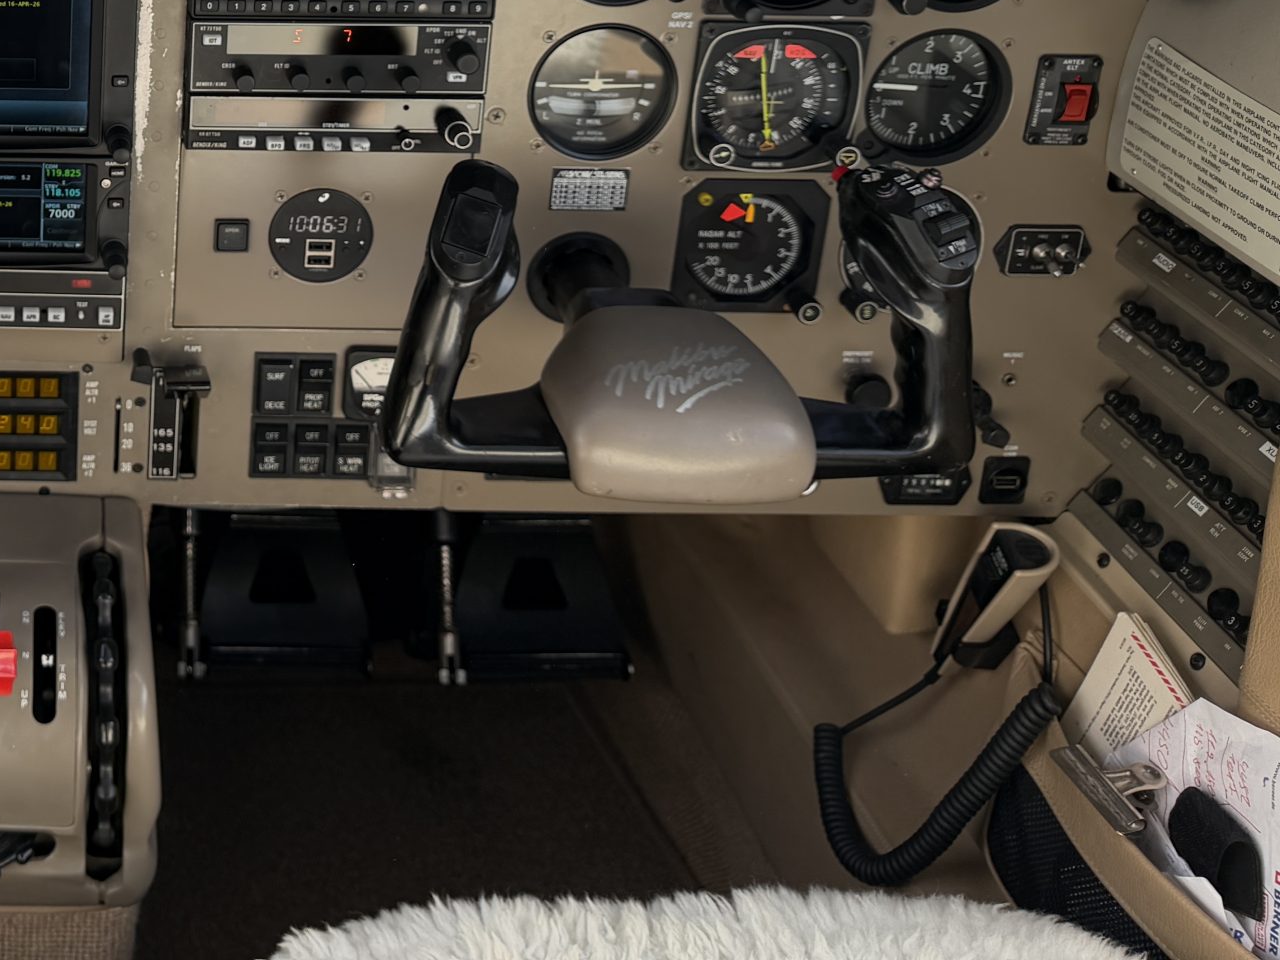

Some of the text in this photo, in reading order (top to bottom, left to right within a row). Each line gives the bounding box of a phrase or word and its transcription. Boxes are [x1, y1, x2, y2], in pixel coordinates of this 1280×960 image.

[908, 62, 948, 75] CLIMB
[1063, 58, 1085, 66] ARTEX
[1243, 106, 1265, 123] AIRPLANE
[1245, 117, 1271, 136] OPERATING
[46, 169, 81, 177] 119.825
[45, 189, 81, 197] 118.105
[1229, 184, 1264, 211] TAKEOFF CLIMB
[49, 209, 75, 218] 7000
[1191, 202, 1210, 217] LANDING
[1211, 214, 1221, 224] NOT
[1155, 254, 1174, 270] AUDIO
[267, 372, 286, 381] SURF
[264, 400, 285, 410] DEICE
[1190, 498, 1205, 513] USB
[1269, 894, 1280, 959] BERNER
